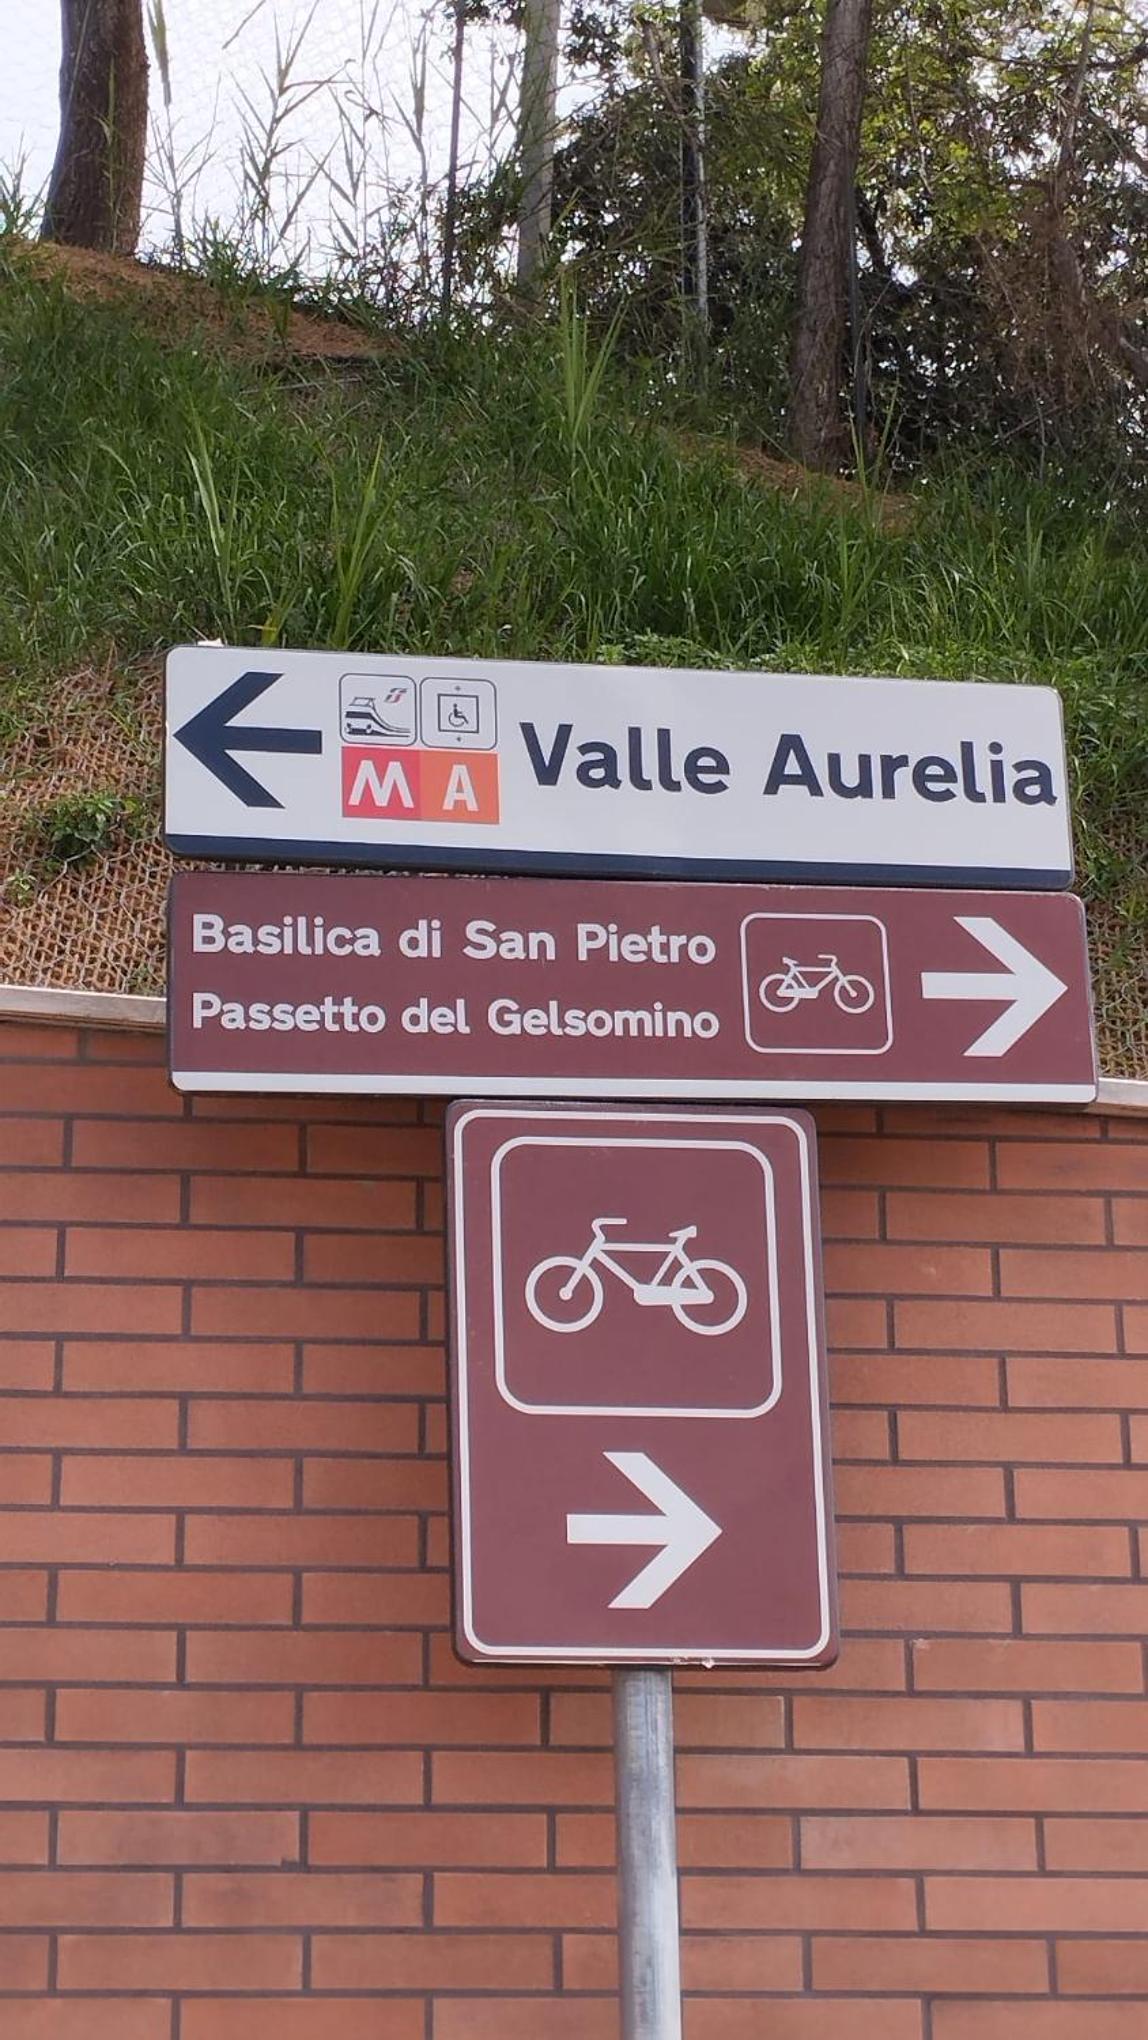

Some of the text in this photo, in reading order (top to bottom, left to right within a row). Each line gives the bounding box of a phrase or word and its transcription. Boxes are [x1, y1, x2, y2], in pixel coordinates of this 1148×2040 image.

[348, 760, 478, 812] M A
[519, 721, 1057, 807] Valle Aurelia
[191, 913, 716, 965] Basilica di San Pietro
[191, 992, 720, 1039] Passetto del Gelsomino
